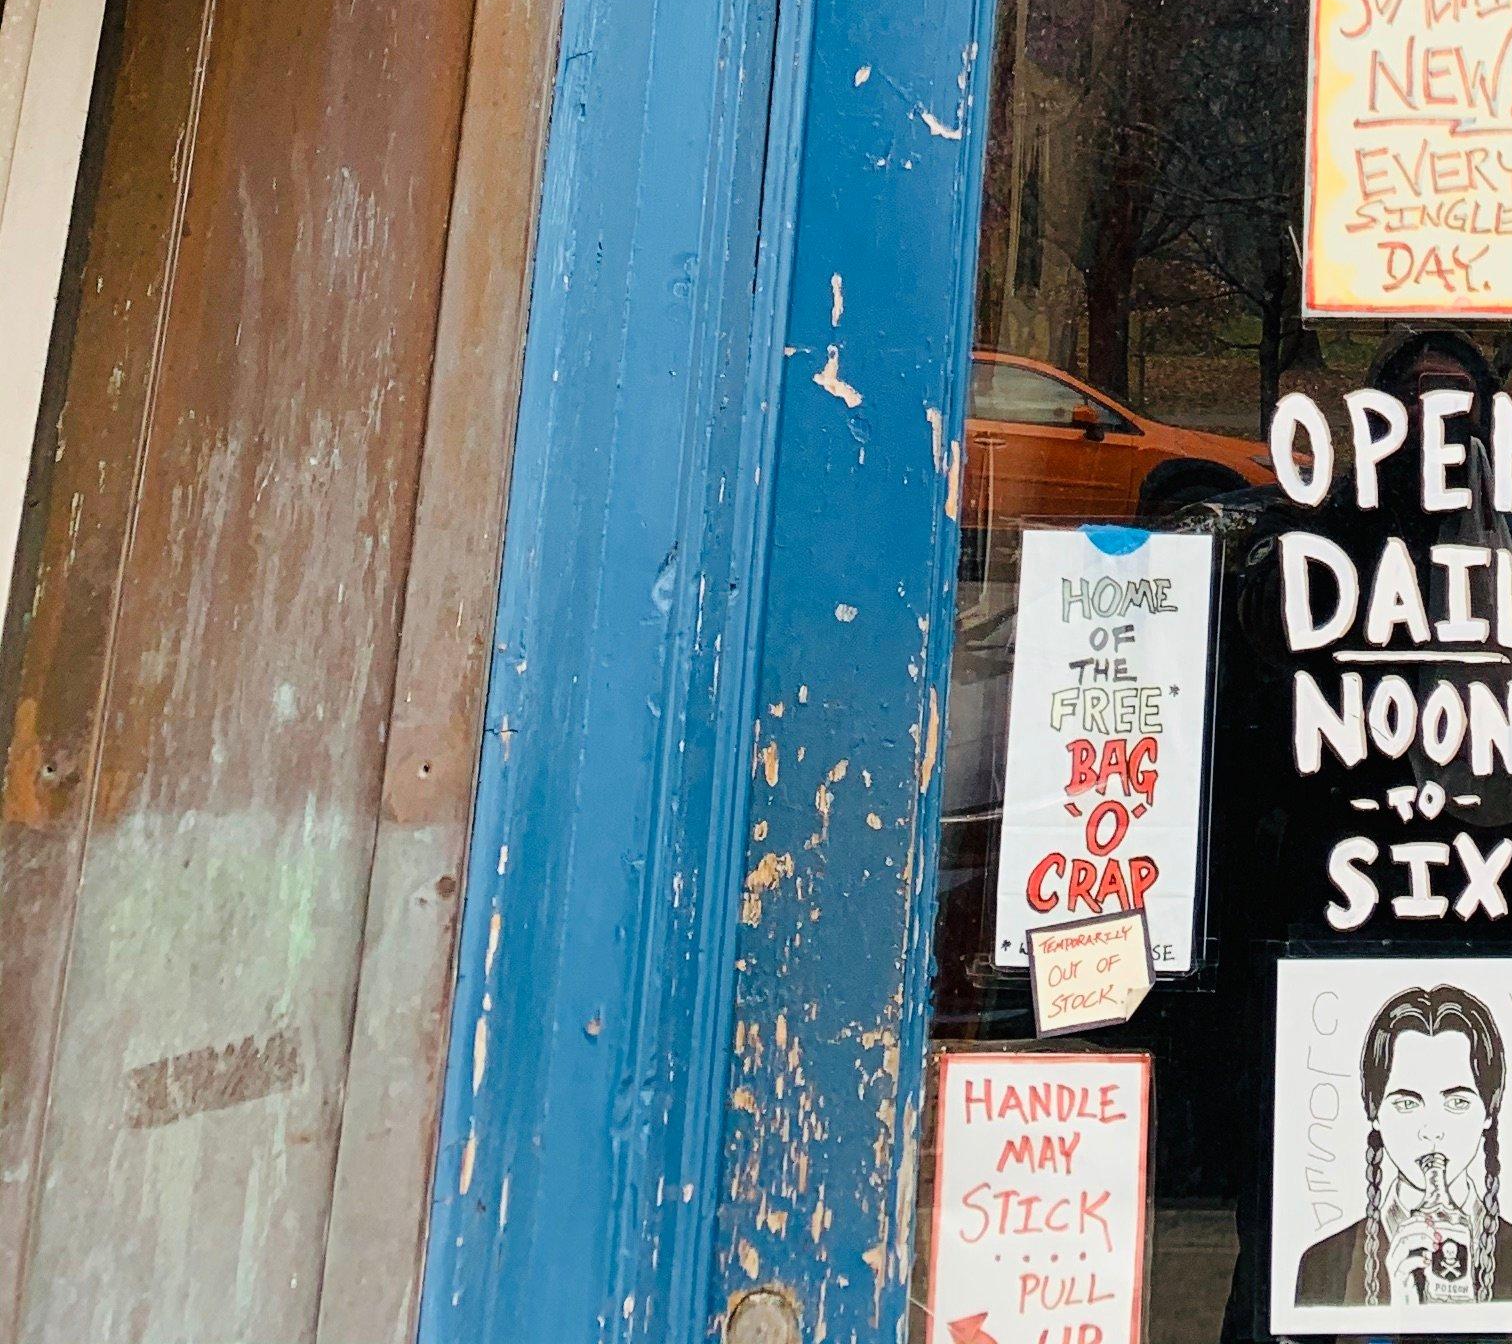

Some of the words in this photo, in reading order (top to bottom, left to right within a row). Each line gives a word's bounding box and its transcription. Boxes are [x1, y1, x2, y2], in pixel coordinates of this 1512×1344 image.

[1377, 242, 1493, 293] DAY.
[1060, 577, 1179, 623] HOME
[1089, 624, 1136, 652] OF
[1069, 658, 1138, 684] THE
[1064, 737, 1159, 806] BAG
[1026, 852, 1160, 915] CRAP
[1037, 924, 1134, 955] TEMPORARILY
[1047, 959, 1084, 988] OUT
[1096, 954, 1122, 974] OF
[964, 1078, 1126, 1125] HANDLE
[996, 1131, 1082, 1175] MAY
[959, 1182, 1113, 1253] STICK
[1018, 1272, 1115, 1314] PULL
